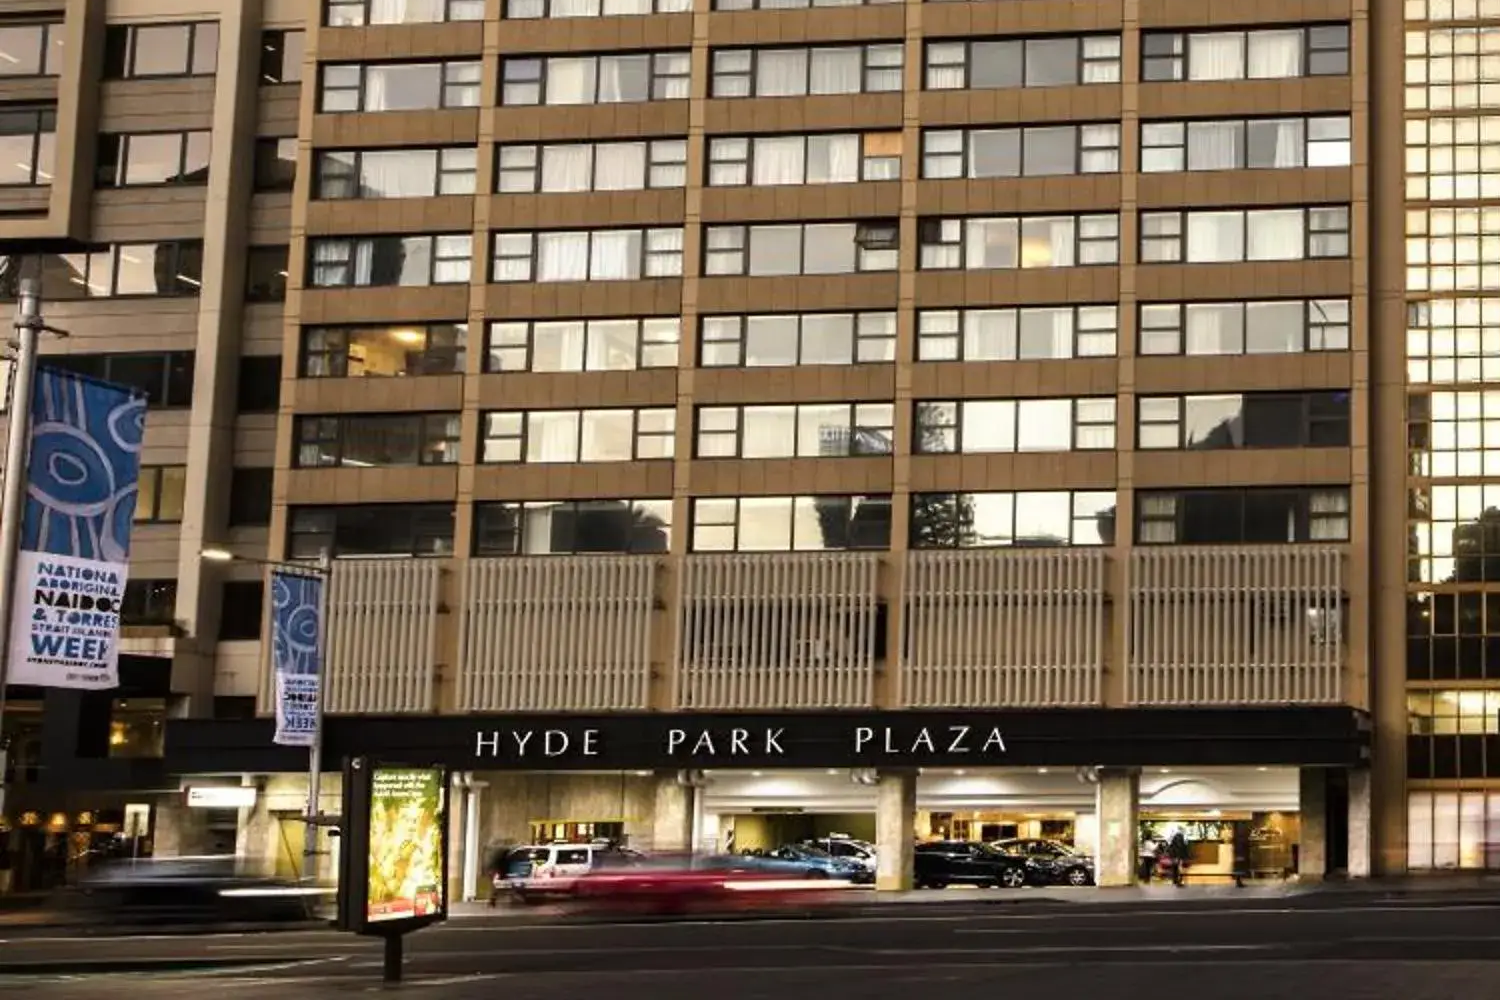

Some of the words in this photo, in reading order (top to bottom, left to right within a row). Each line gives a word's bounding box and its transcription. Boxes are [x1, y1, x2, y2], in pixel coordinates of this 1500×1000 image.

[37, 561, 119, 585] NATIONA
[37, 577, 120, 597] ABORIGINA
[34, 589, 121, 613] NAIDOC
[32, 607, 46, 621] &
[475, 729, 600, 757] HYDE
[667, 728, 785, 756] PARK
[855, 727, 1007, 754] PLAZA
